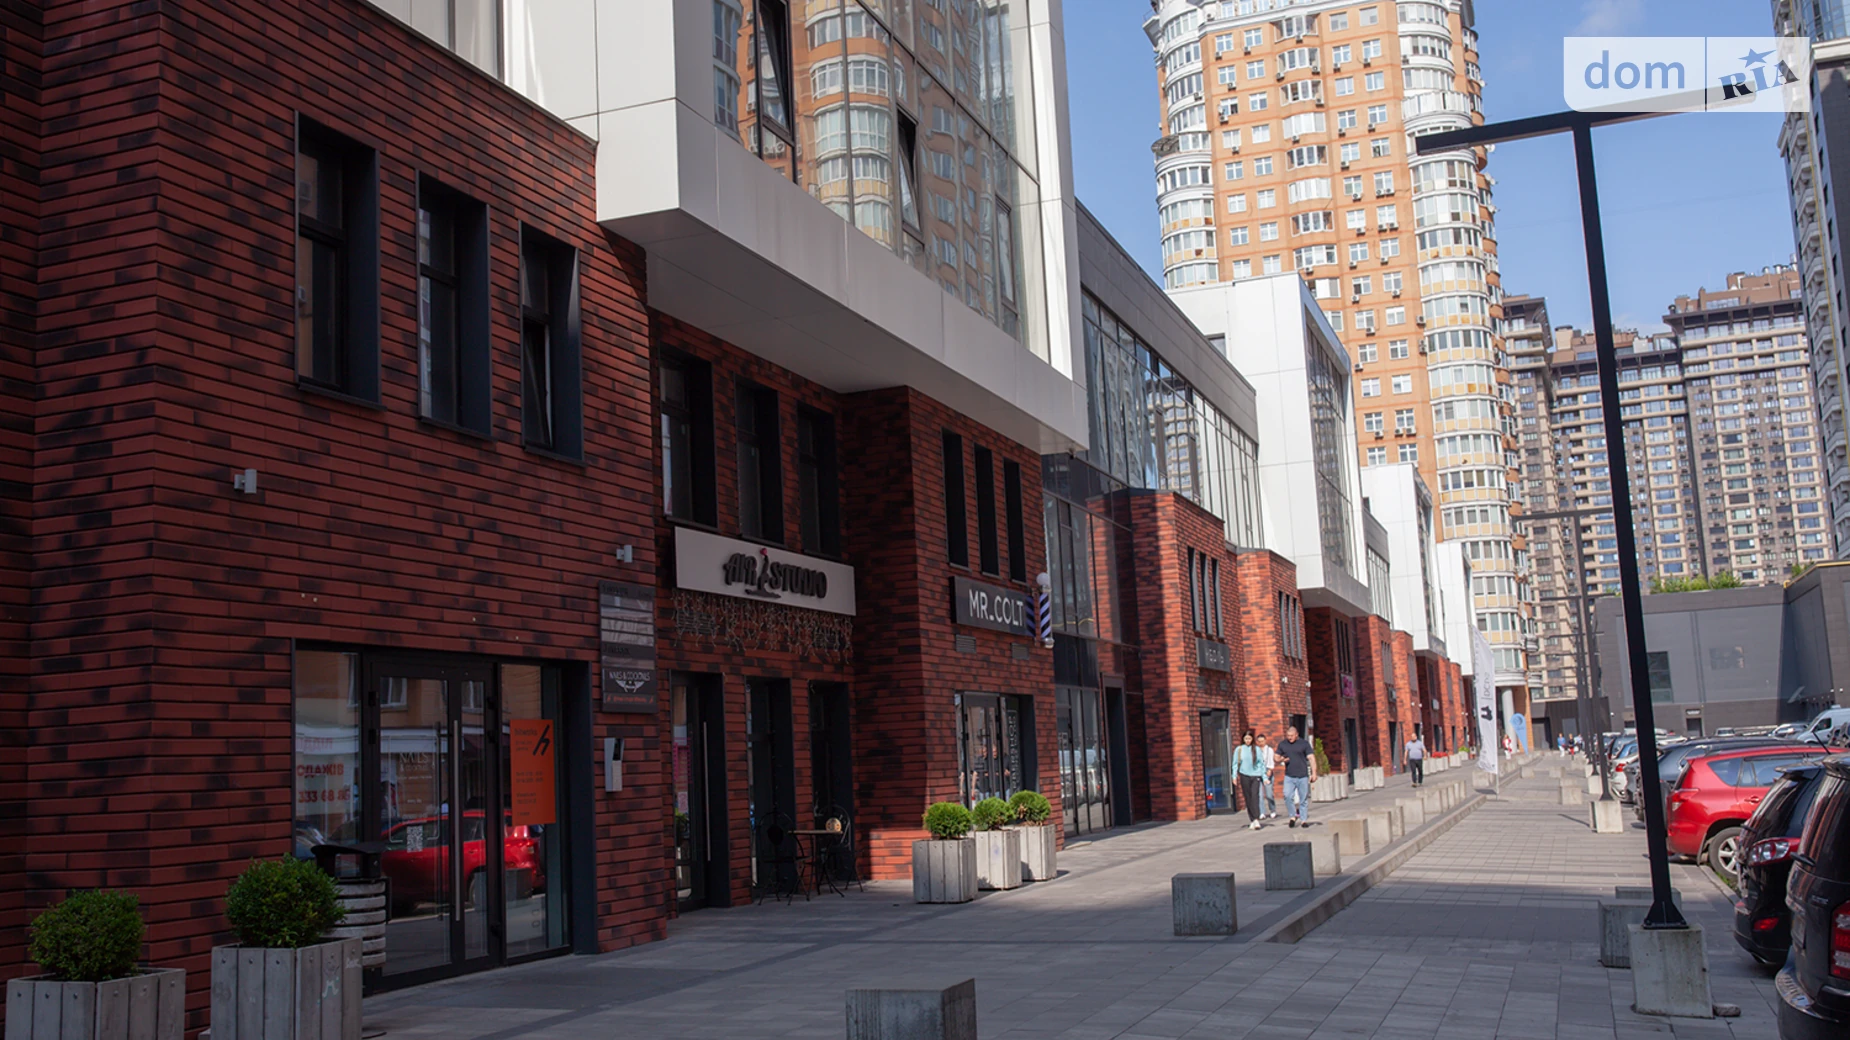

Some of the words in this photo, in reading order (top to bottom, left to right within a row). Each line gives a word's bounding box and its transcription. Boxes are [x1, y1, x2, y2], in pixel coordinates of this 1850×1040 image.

[723, 553, 757, 586] AIR
[770, 562, 828, 599] STUDIO
[298, 790, 318, 803] 333
